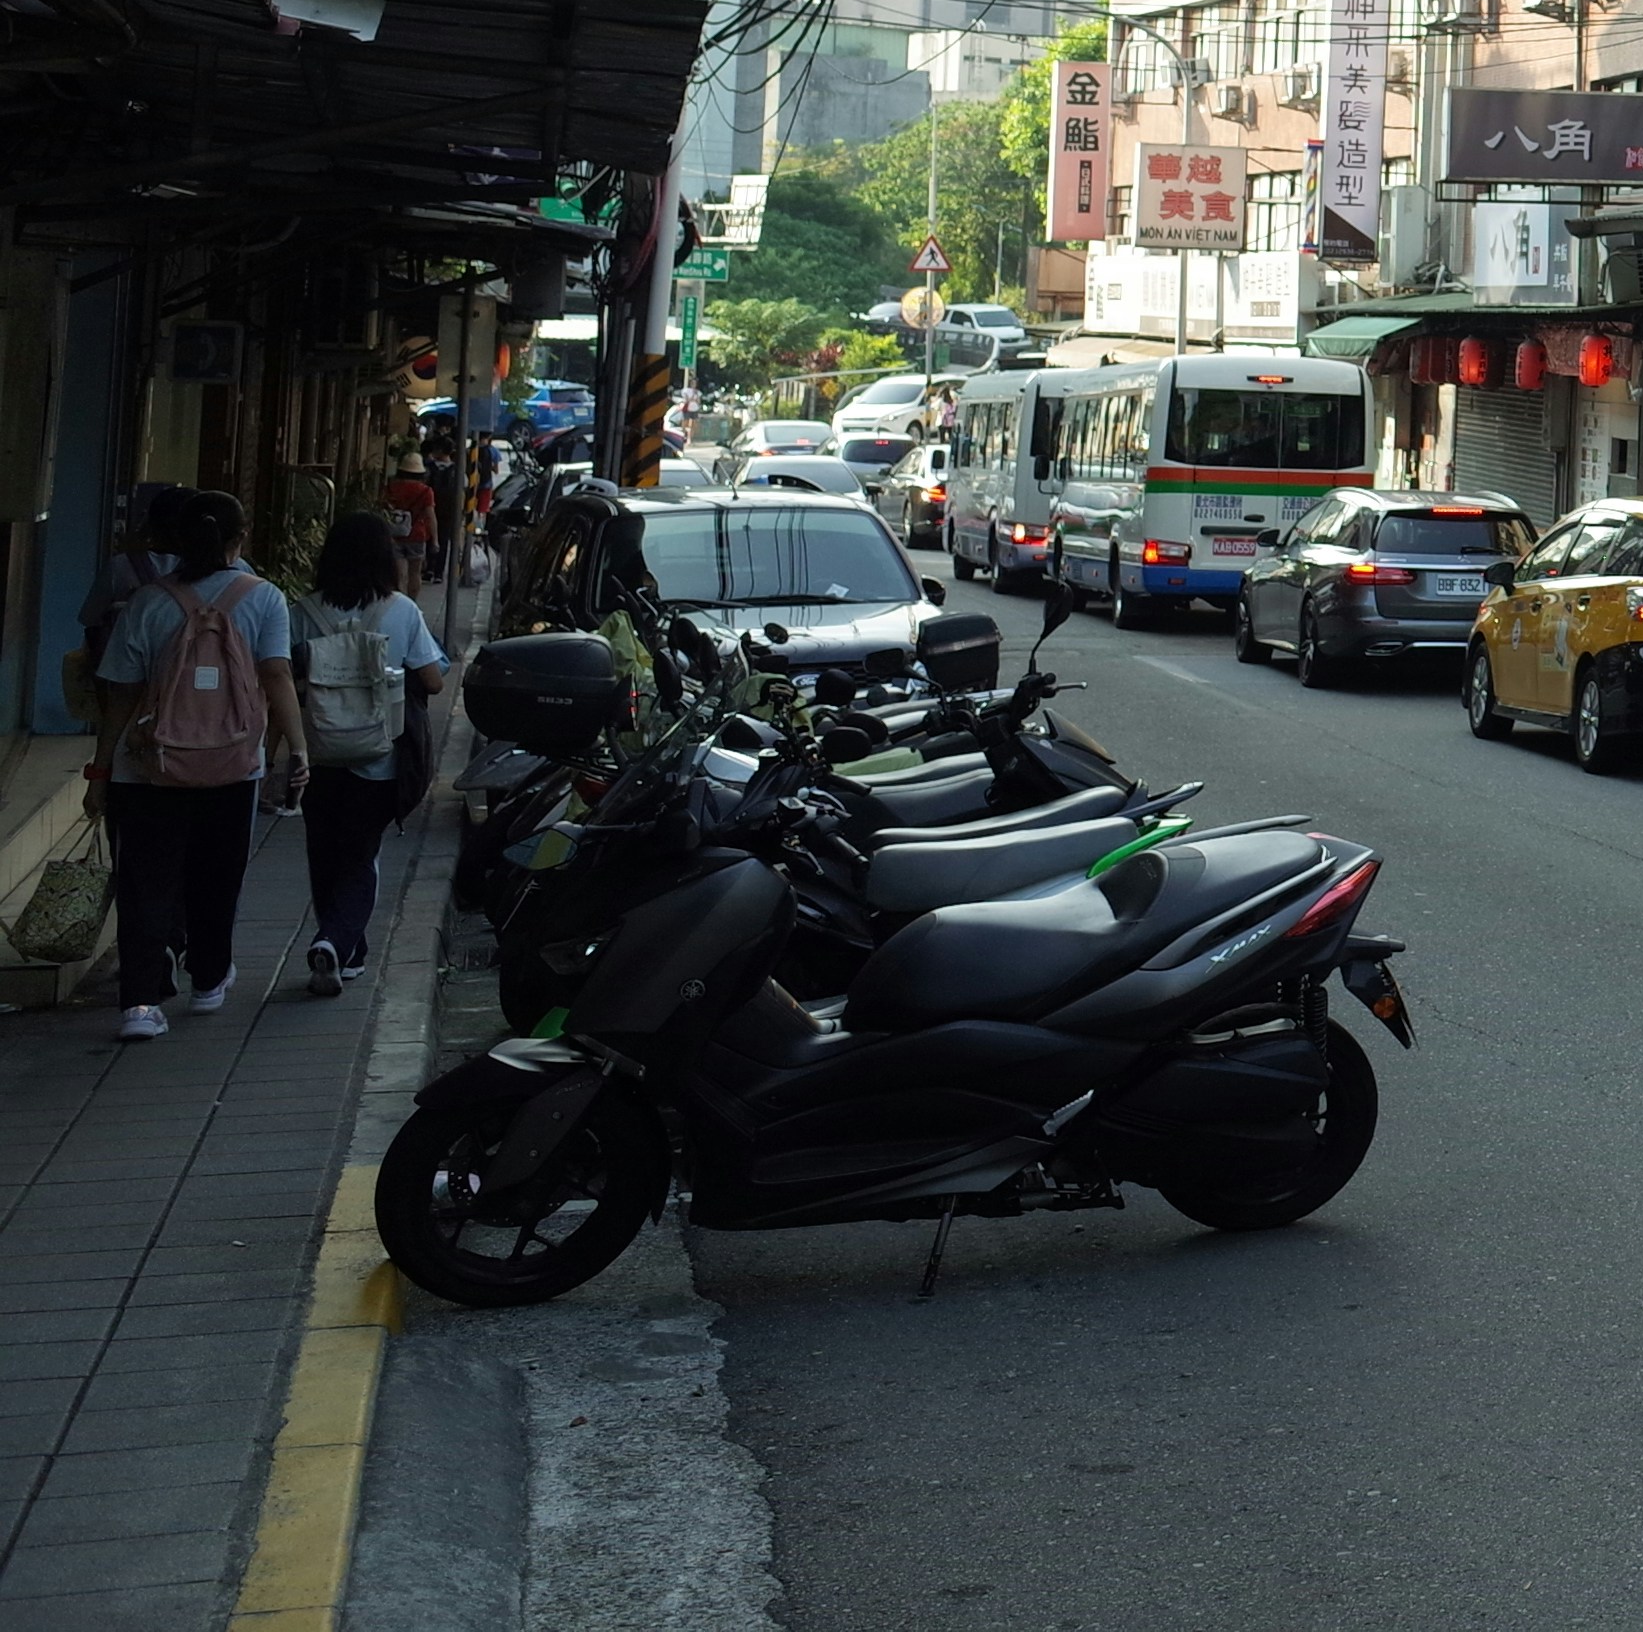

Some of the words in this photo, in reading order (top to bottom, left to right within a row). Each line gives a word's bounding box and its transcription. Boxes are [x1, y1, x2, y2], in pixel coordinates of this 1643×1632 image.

[1064, 71, 1101, 152] 金鮨
[1484, 119, 1593, 161] 八角
[1159, 189, 1236, 222] 美食
